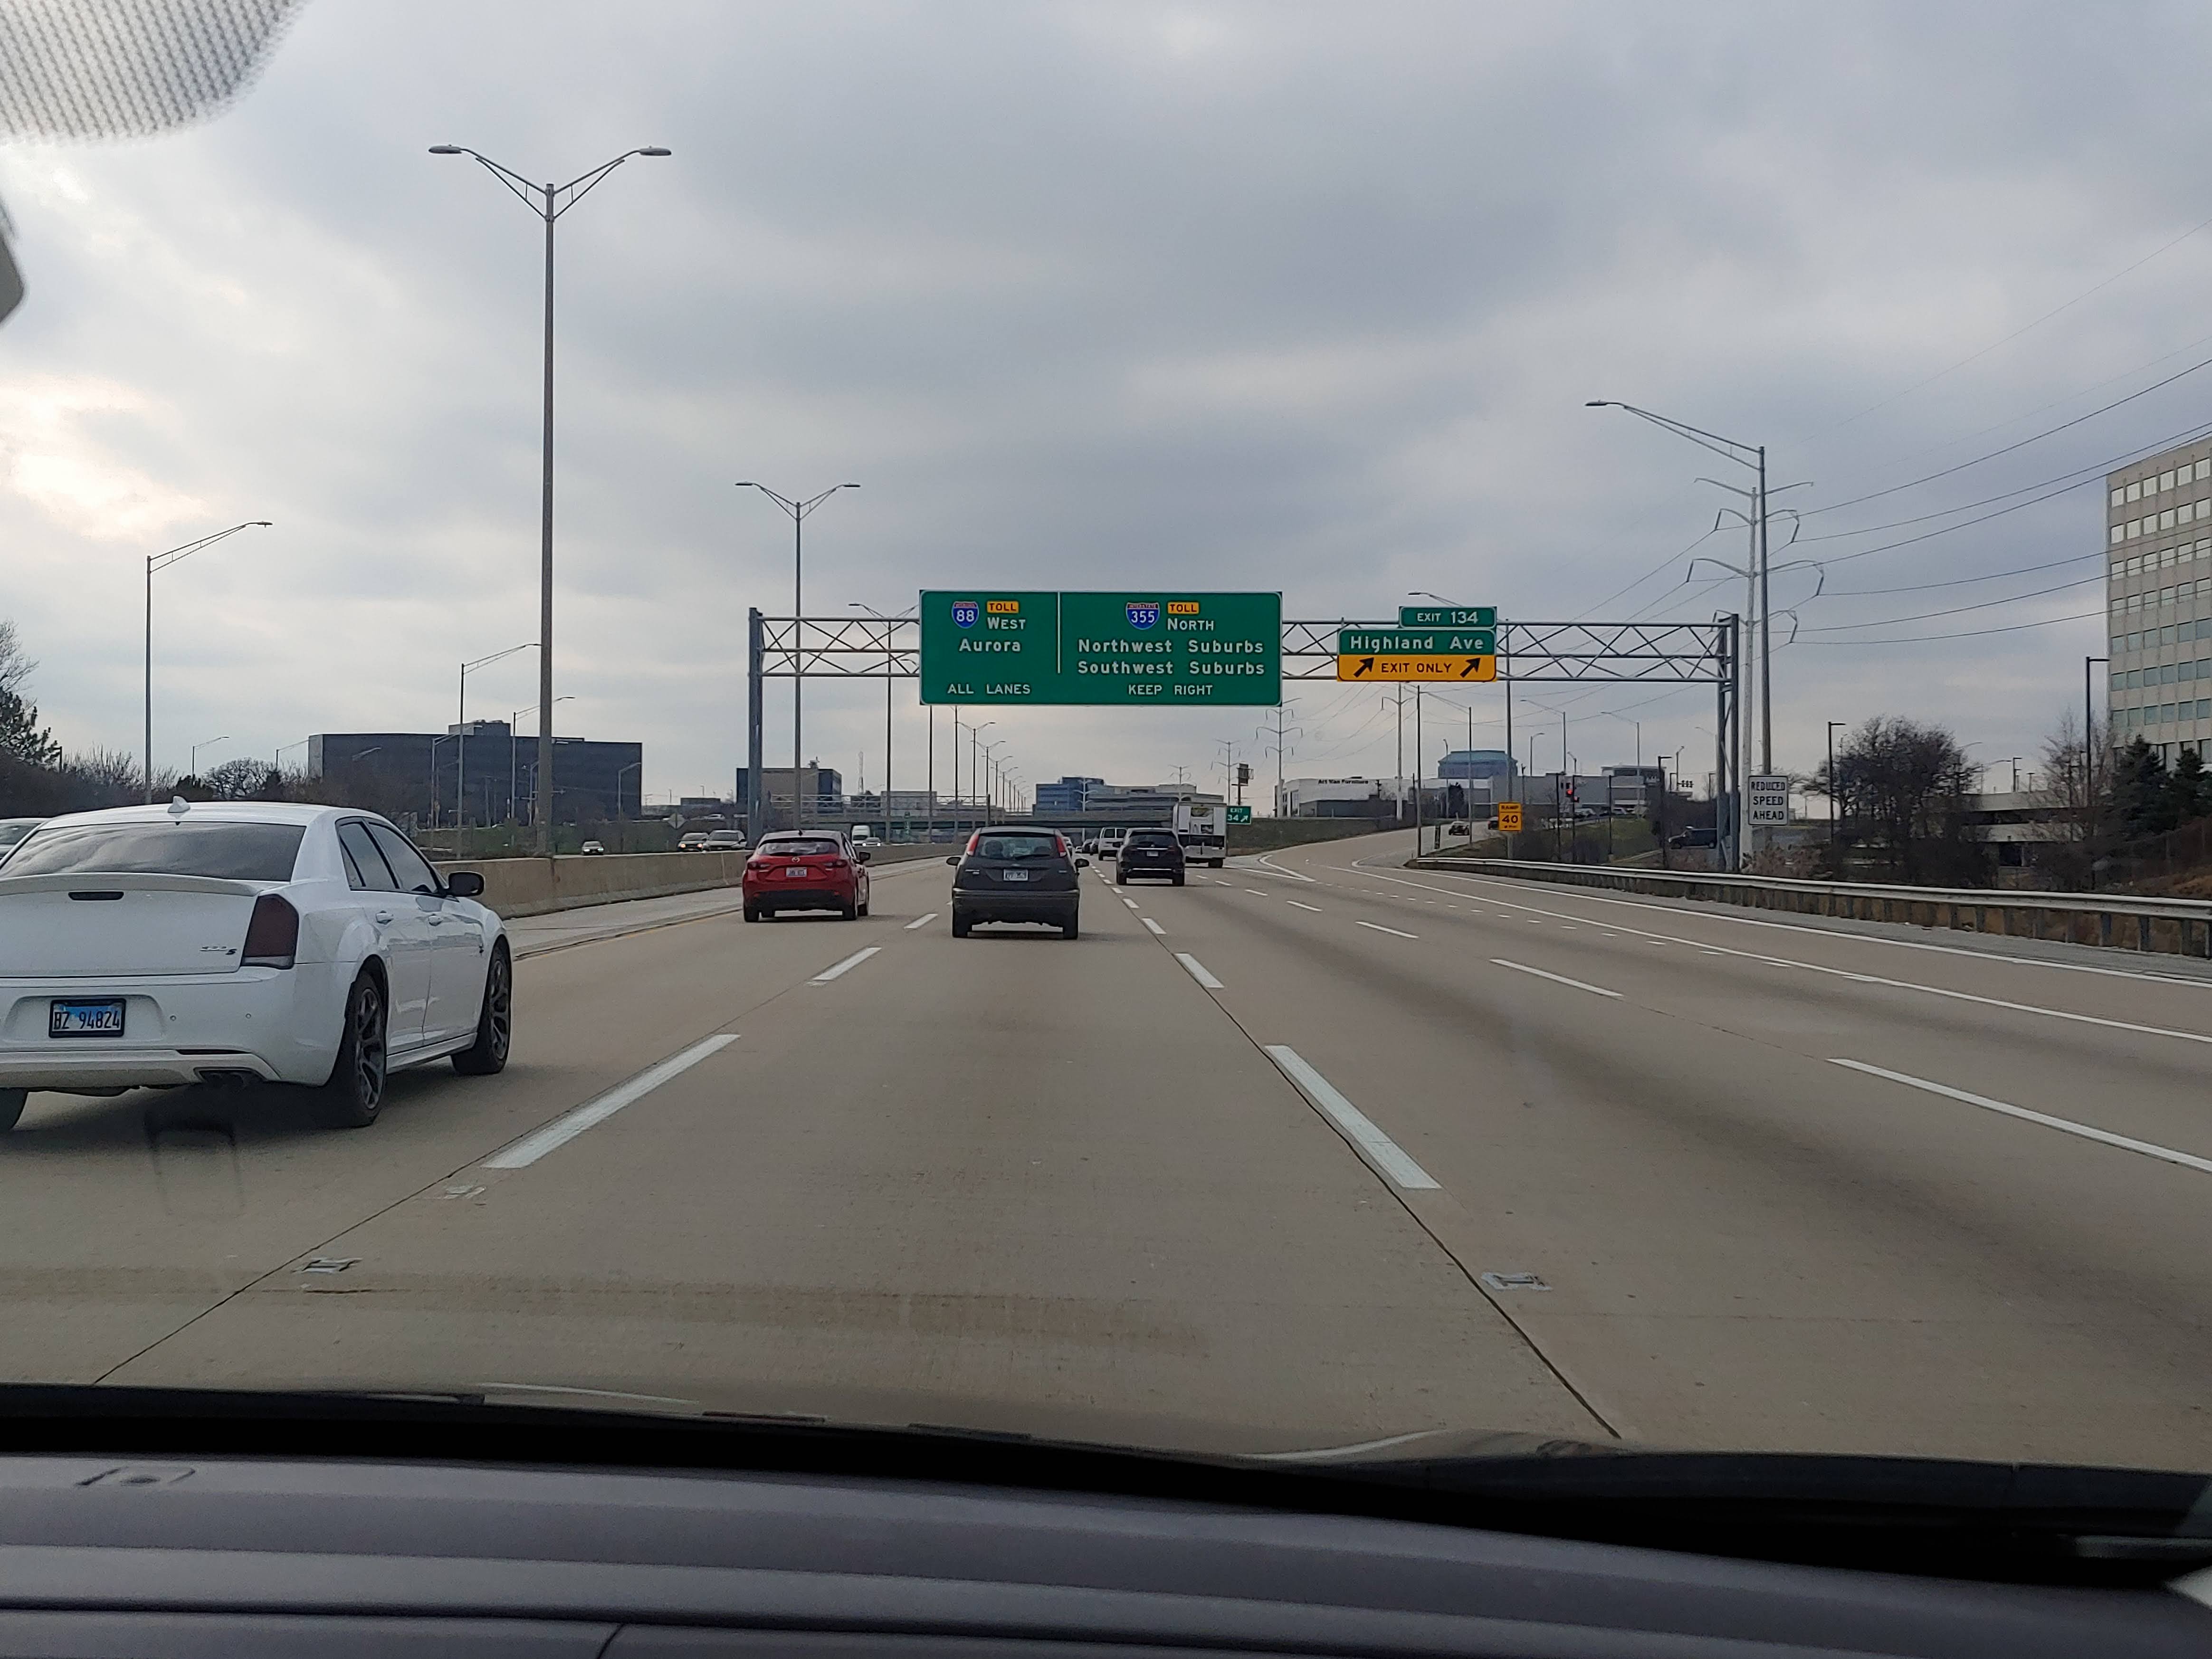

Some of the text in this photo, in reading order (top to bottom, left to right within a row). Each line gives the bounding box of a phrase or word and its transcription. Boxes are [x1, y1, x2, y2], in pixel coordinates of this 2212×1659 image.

[989, 603, 1017, 611] TOLL
[1170, 604, 1197, 612] TOLL
[956, 610, 974, 622] 88
[1131, 611, 1155, 623] 355
[1417, 611, 1478, 624] EXIT 134
[987, 617, 1026, 629] WEST
[1167, 618, 1214, 630] NORTH
[959, 638, 1021, 651] Aurora
[1078, 639, 1263, 653] Northwest Suburbs
[1351, 636, 1484, 653] Highland Ave
[1078, 660, 1265, 675] Southwest Suburbs
[1381, 663, 1452, 673] EXIT ONLY
[947, 684, 1030, 694] ALL LANES
[1128, 685, 1212, 695] KEEP RIGHT
[1751, 782, 1785, 791] REDUCED
[1753, 796, 1783, 805] SPEED
[1502, 815, 1518, 823] 40
[1753, 810, 1784, 820] AHEAD
[54, 1011, 119, 1029] BZ 94824
